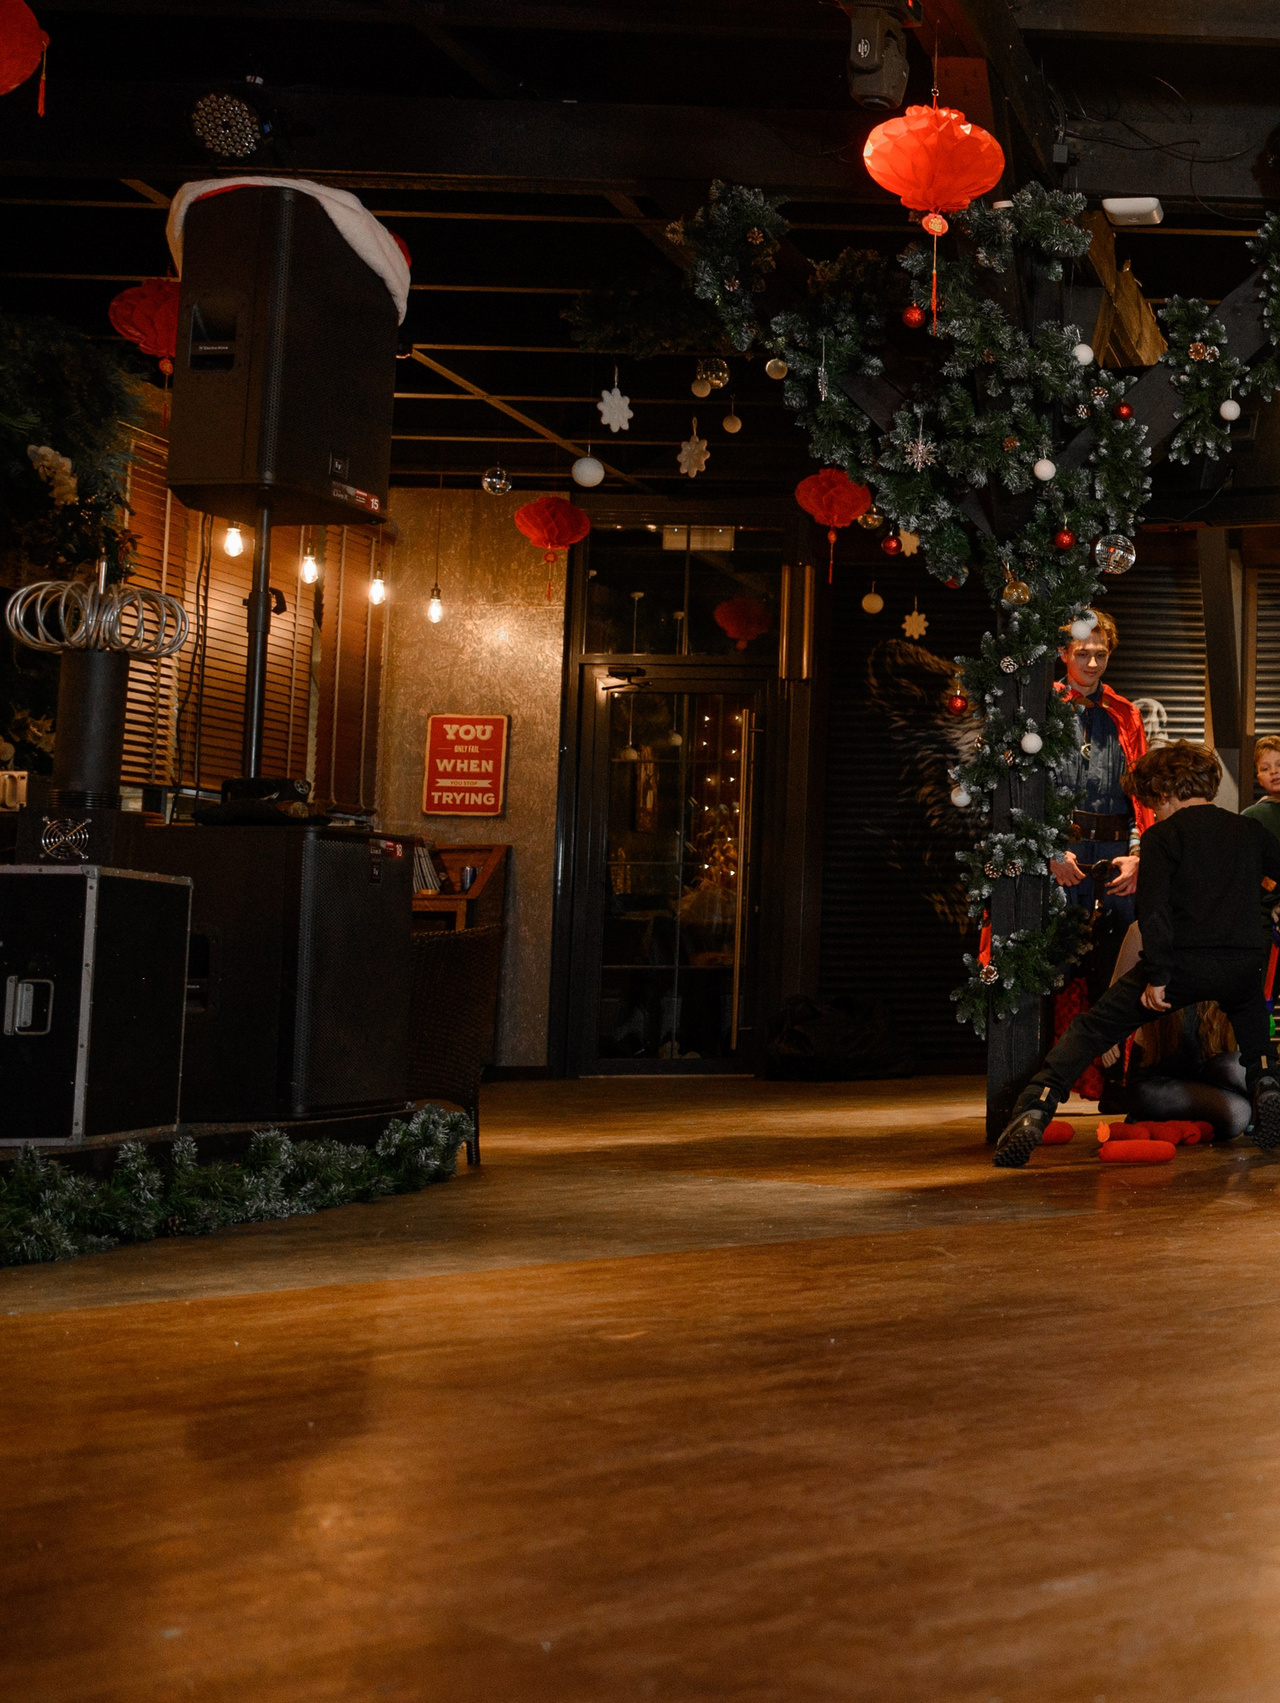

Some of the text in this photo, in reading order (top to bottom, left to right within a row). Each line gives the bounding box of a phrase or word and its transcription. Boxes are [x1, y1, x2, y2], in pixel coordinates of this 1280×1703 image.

[370, 497, 379, 510] 15
[443, 724, 494, 741] YOU
[454, 744, 480, 753] ONLY FAIL
[435, 758, 494, 773] WHEN
[431, 791, 495, 806] TRYING
